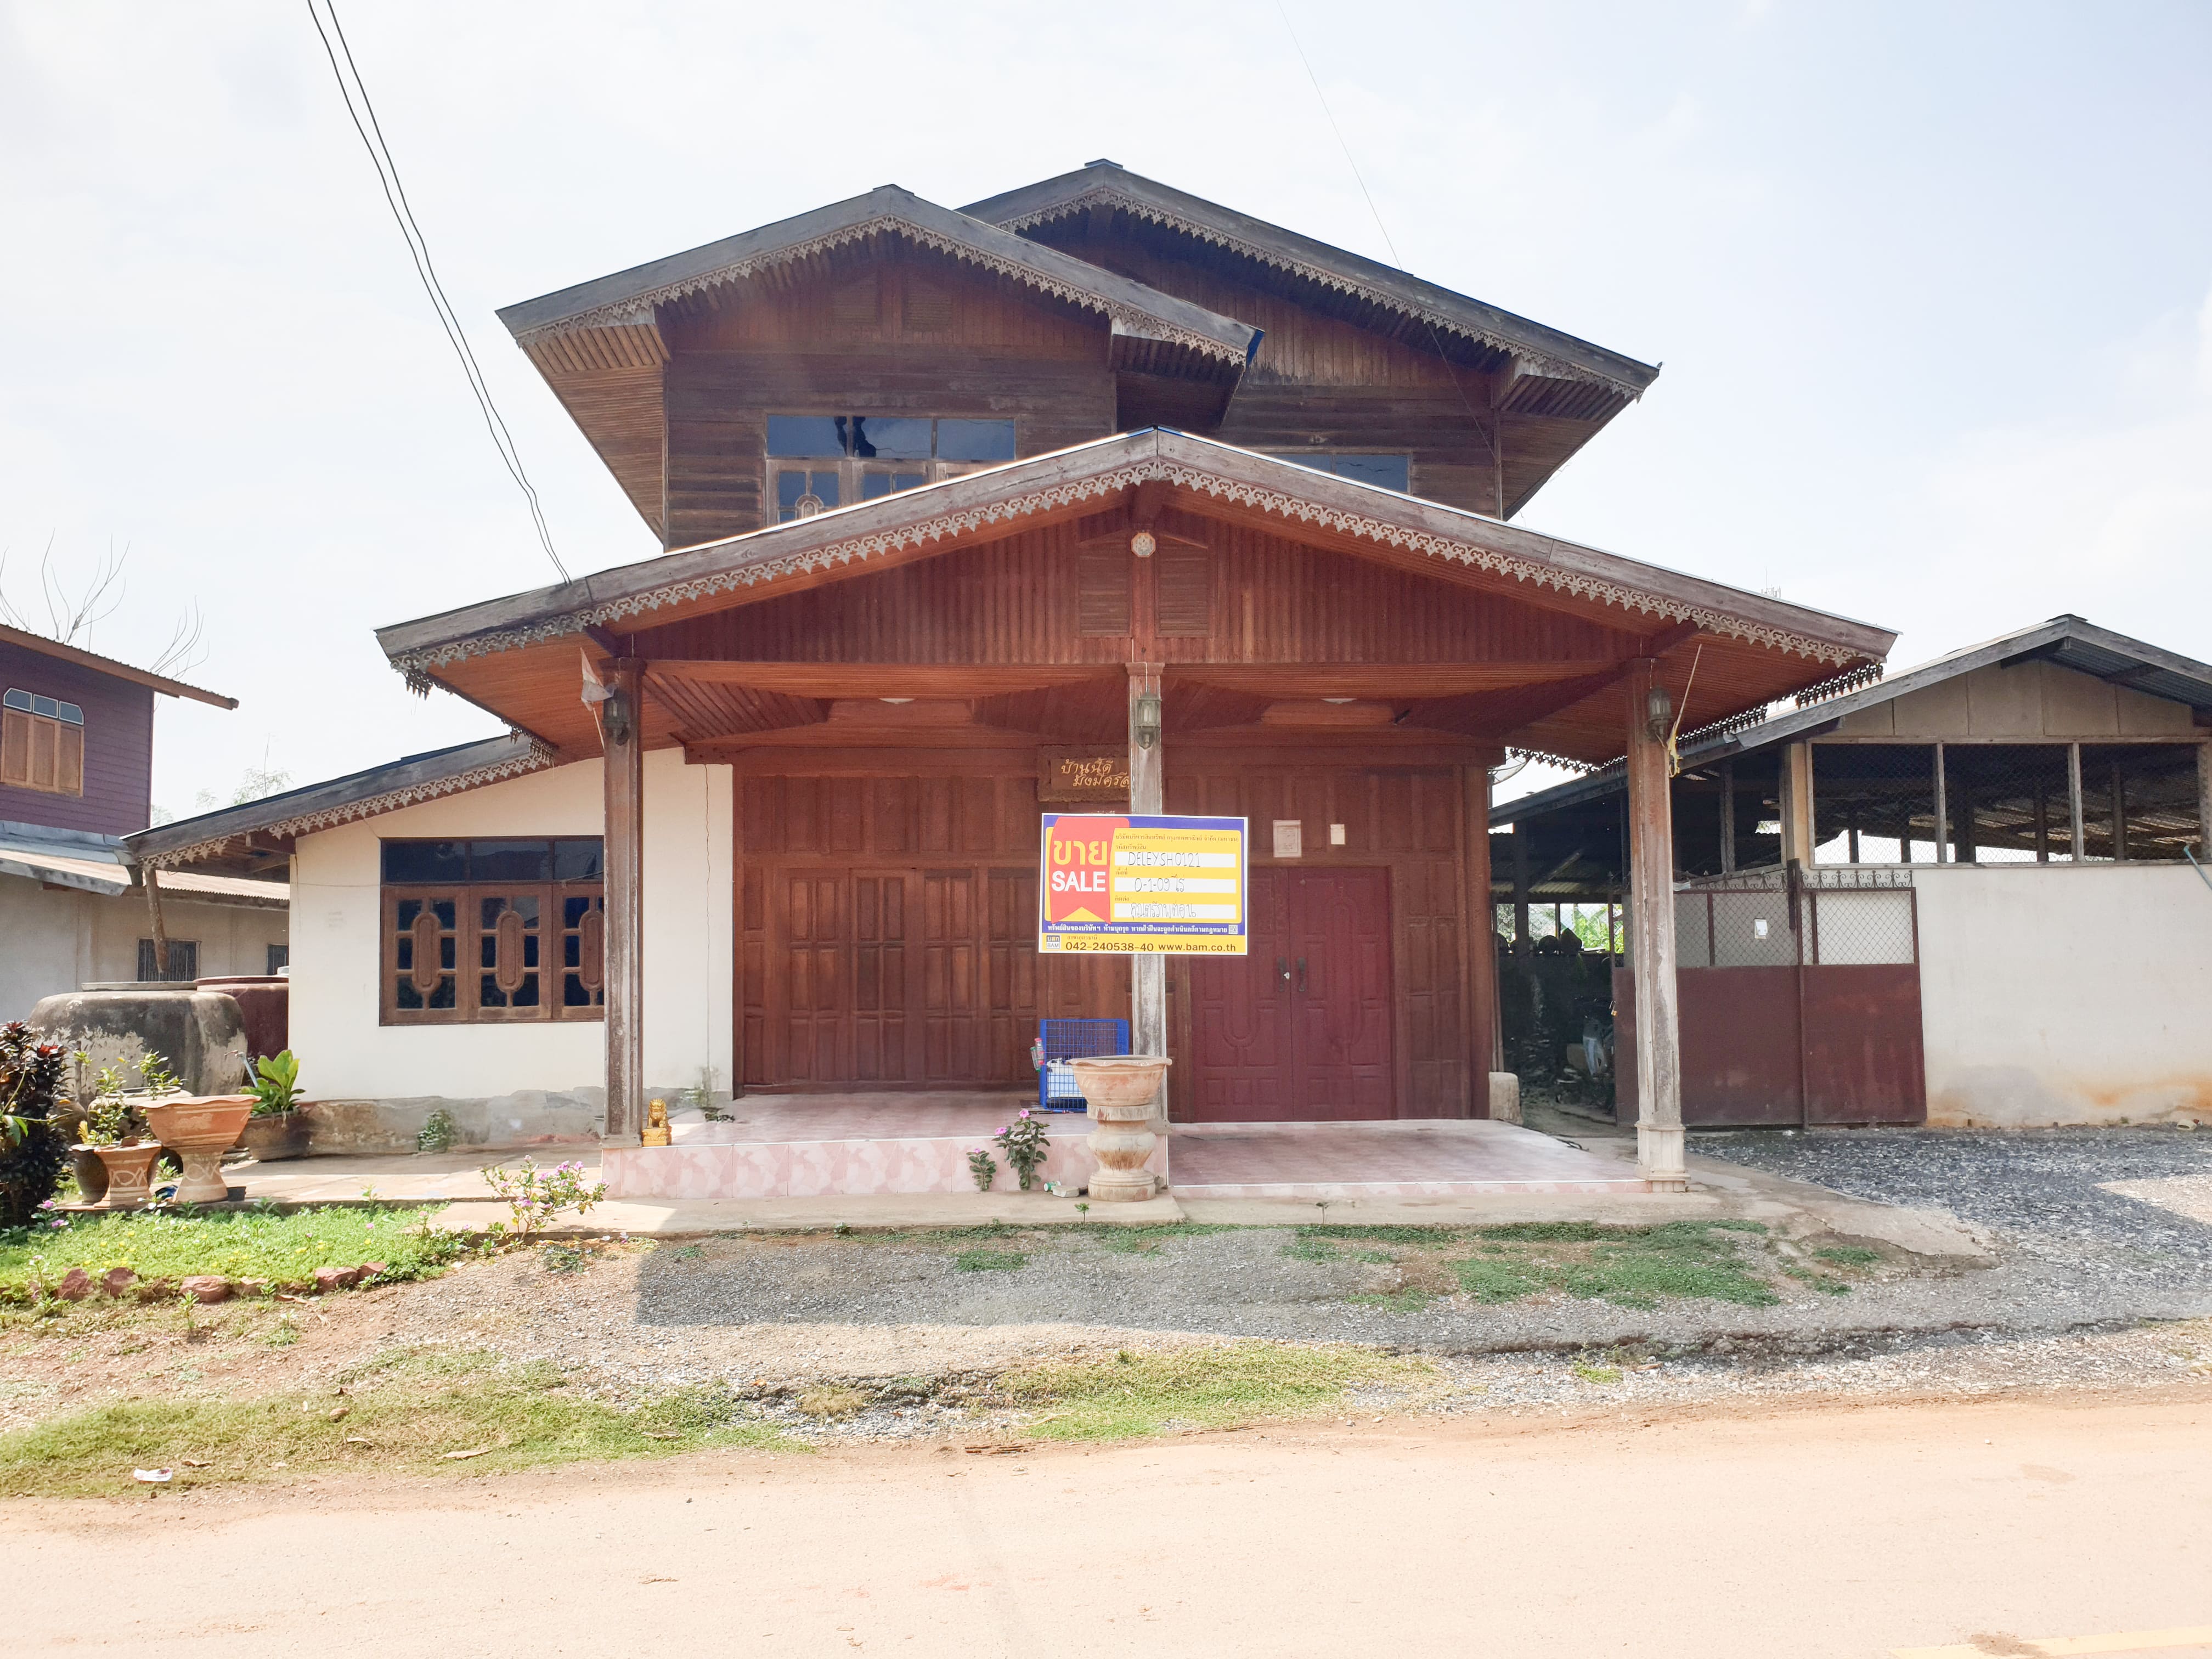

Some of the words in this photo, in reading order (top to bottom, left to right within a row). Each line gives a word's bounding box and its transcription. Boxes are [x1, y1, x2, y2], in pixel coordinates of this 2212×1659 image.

[1053, 840, 1107, 865] ขาย
[1051, 871, 1106, 892] SALE
[1135, 878, 1170, 892] 0-1-09
[1103, 924, 1129, 933] ห้ามบุกรุก
[1065, 941, 1154, 952] 042-240538-40
[1158, 943, 1236, 952] www.bam.co.th
